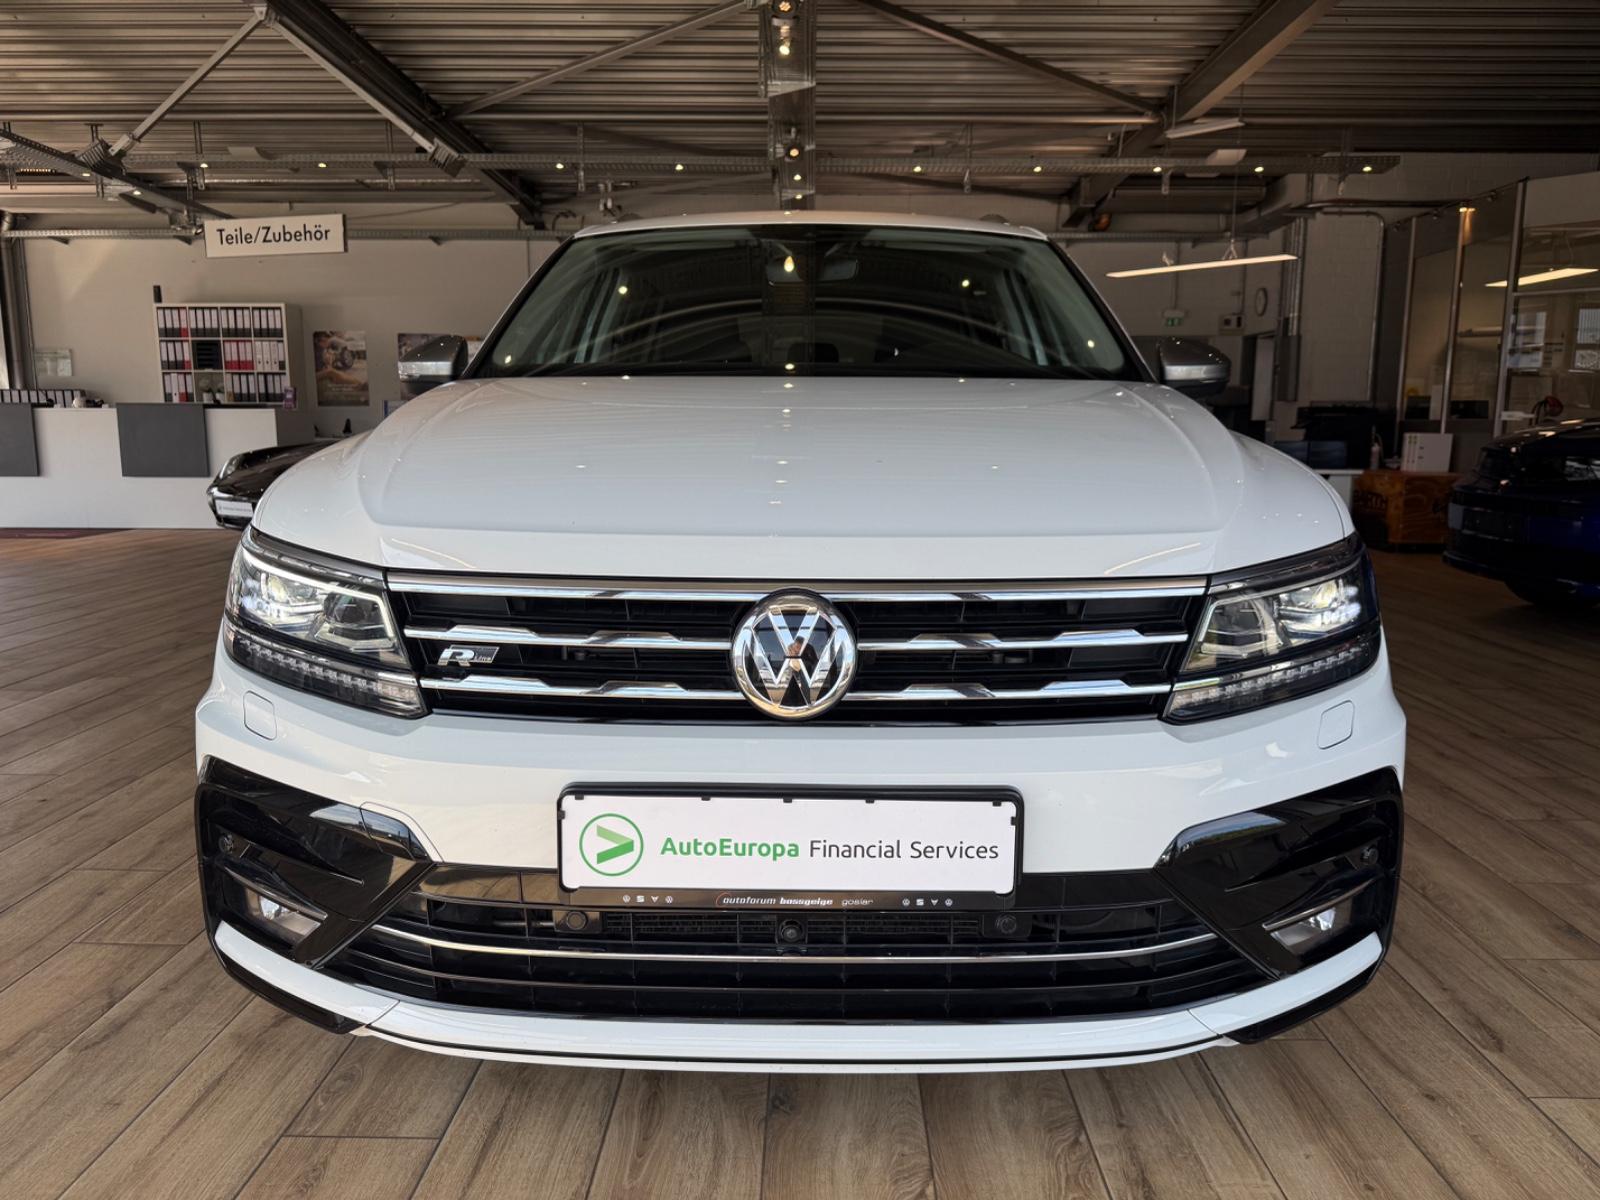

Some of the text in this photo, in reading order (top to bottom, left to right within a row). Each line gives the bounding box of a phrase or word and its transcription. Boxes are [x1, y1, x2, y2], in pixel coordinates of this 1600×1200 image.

[216, 223, 331, 246] Teile/Zubehör
[740, 600, 846, 711] VW
[660, 837, 1000, 862] AutoEuropa Financial Services
[722, 895, 777, 905] autoforum
